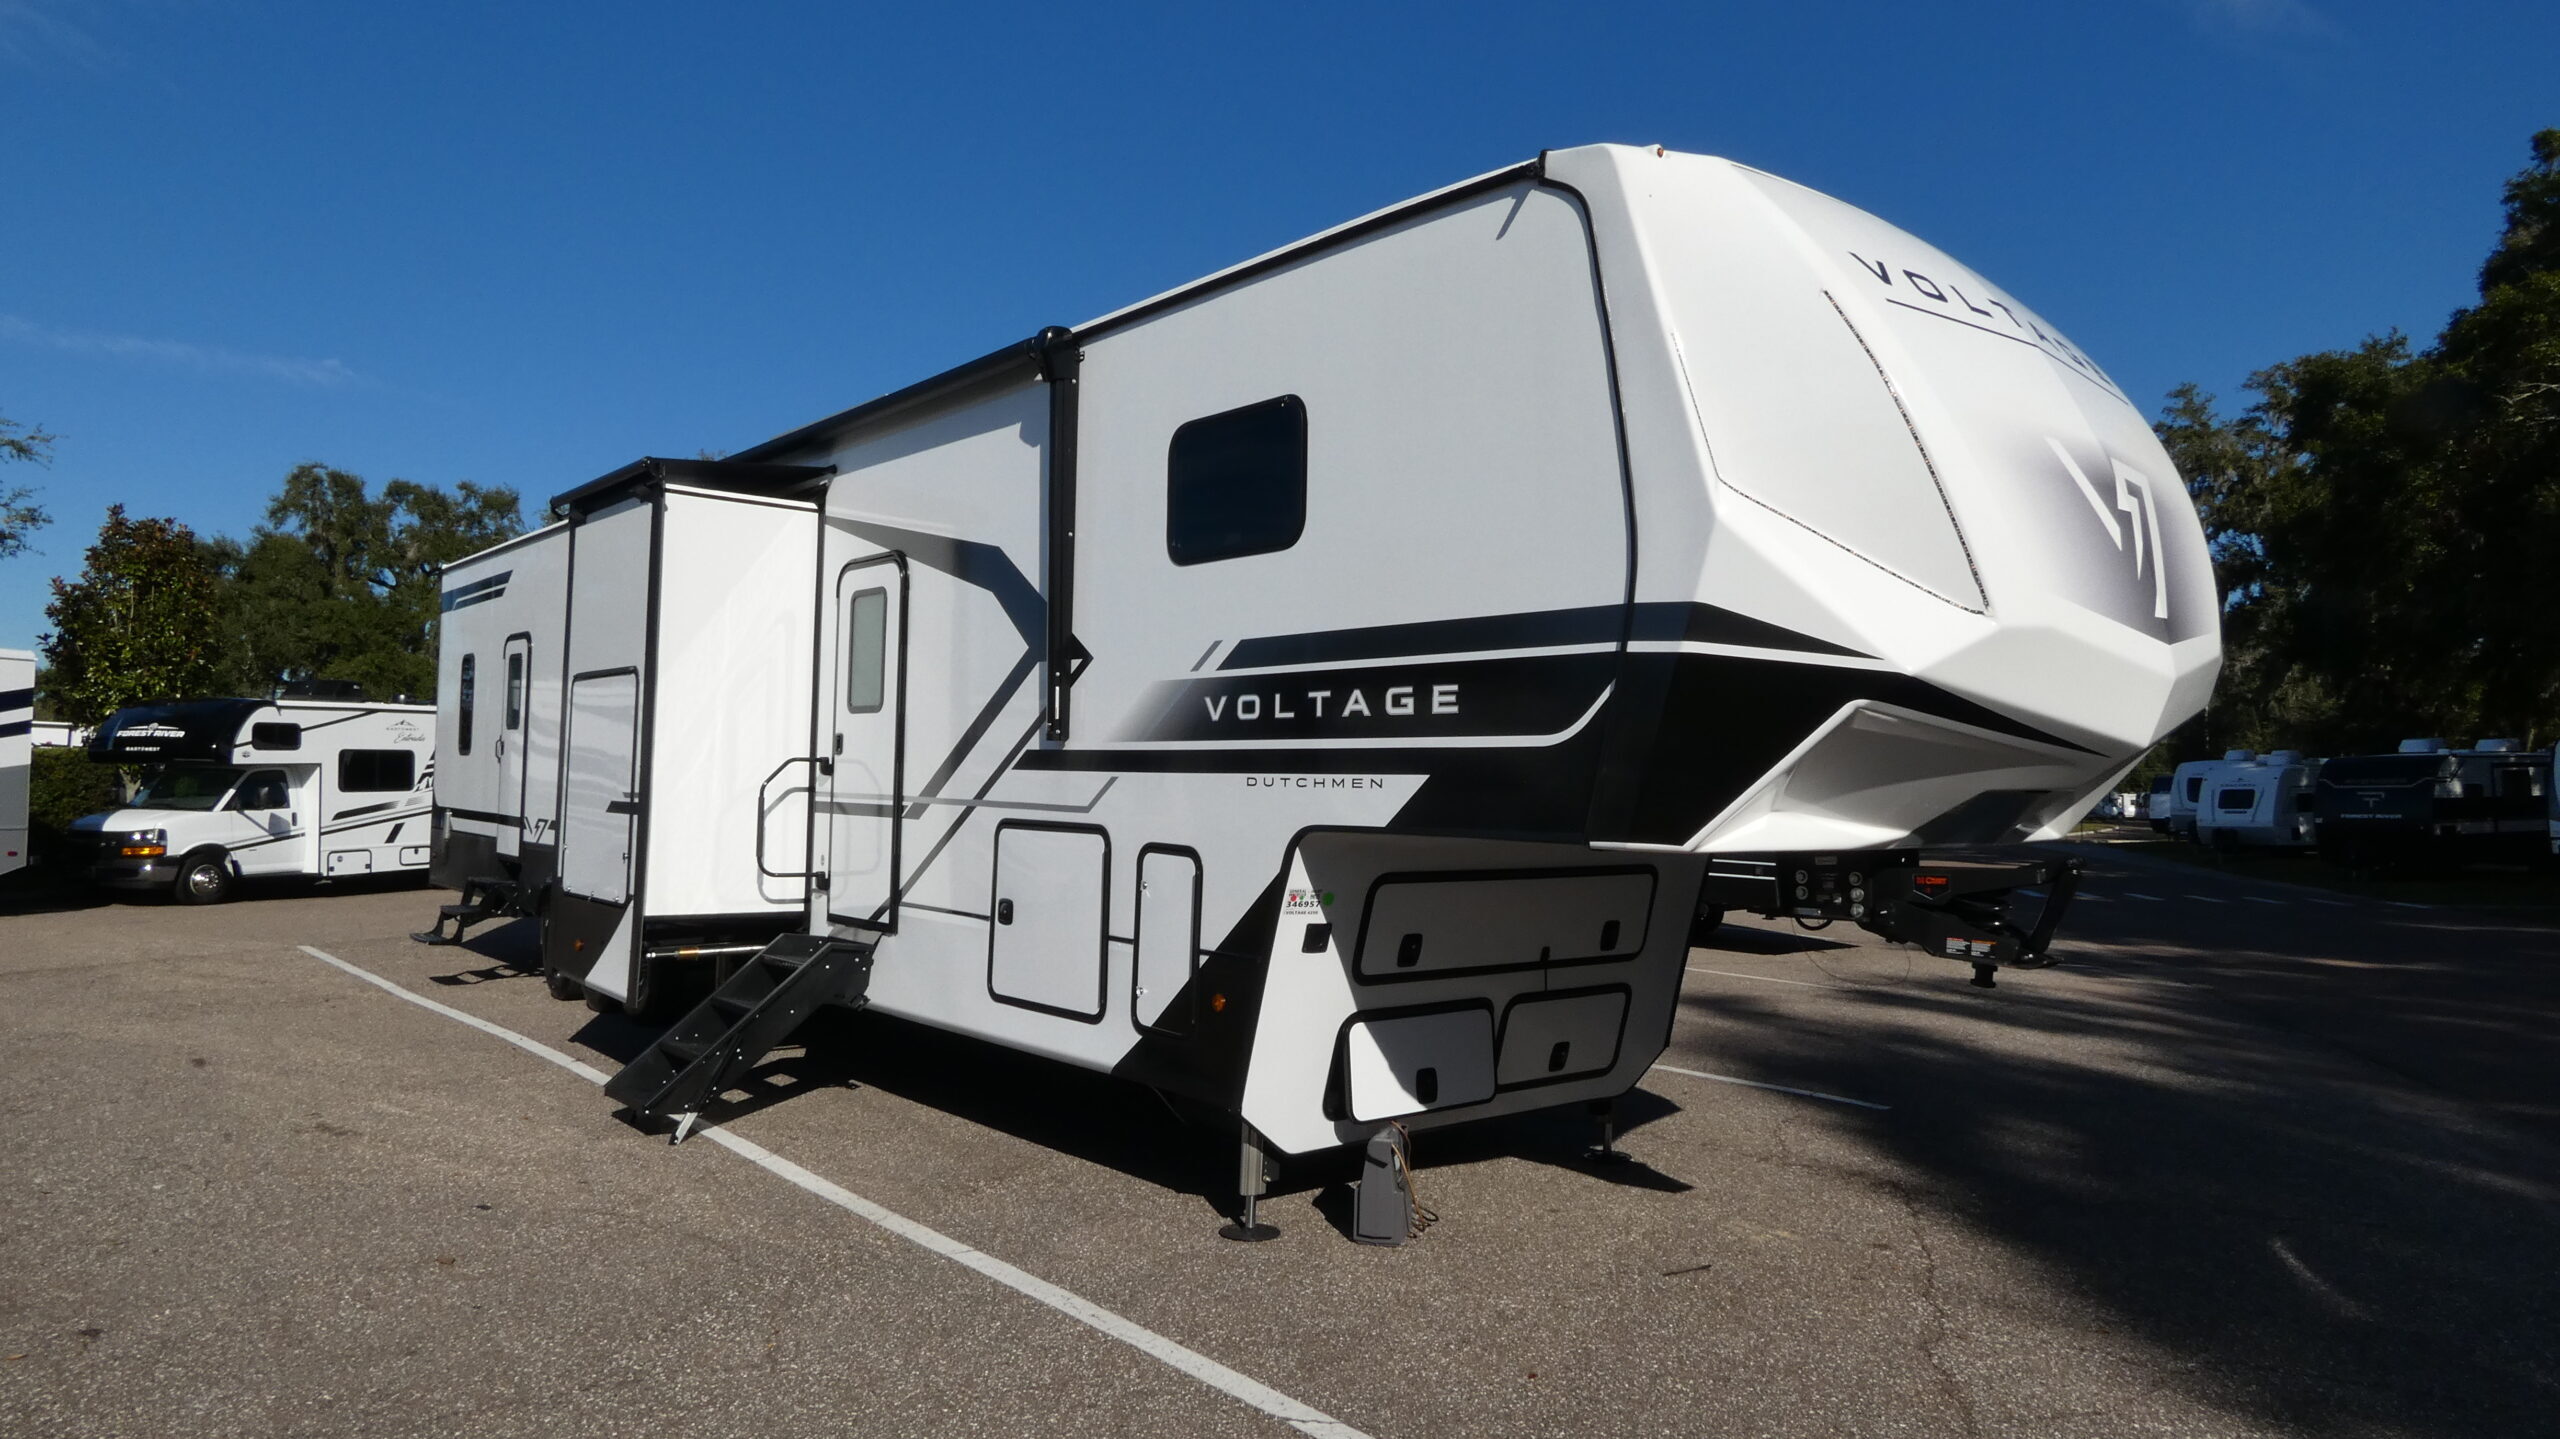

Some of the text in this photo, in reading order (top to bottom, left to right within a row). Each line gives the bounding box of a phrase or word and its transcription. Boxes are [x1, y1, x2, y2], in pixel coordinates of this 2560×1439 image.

[1204, 684, 1459, 722] VOLTAGE
[116, 729, 186, 739] FOREST RIVER
[1246, 776, 1384, 790] DUTCHMEN
